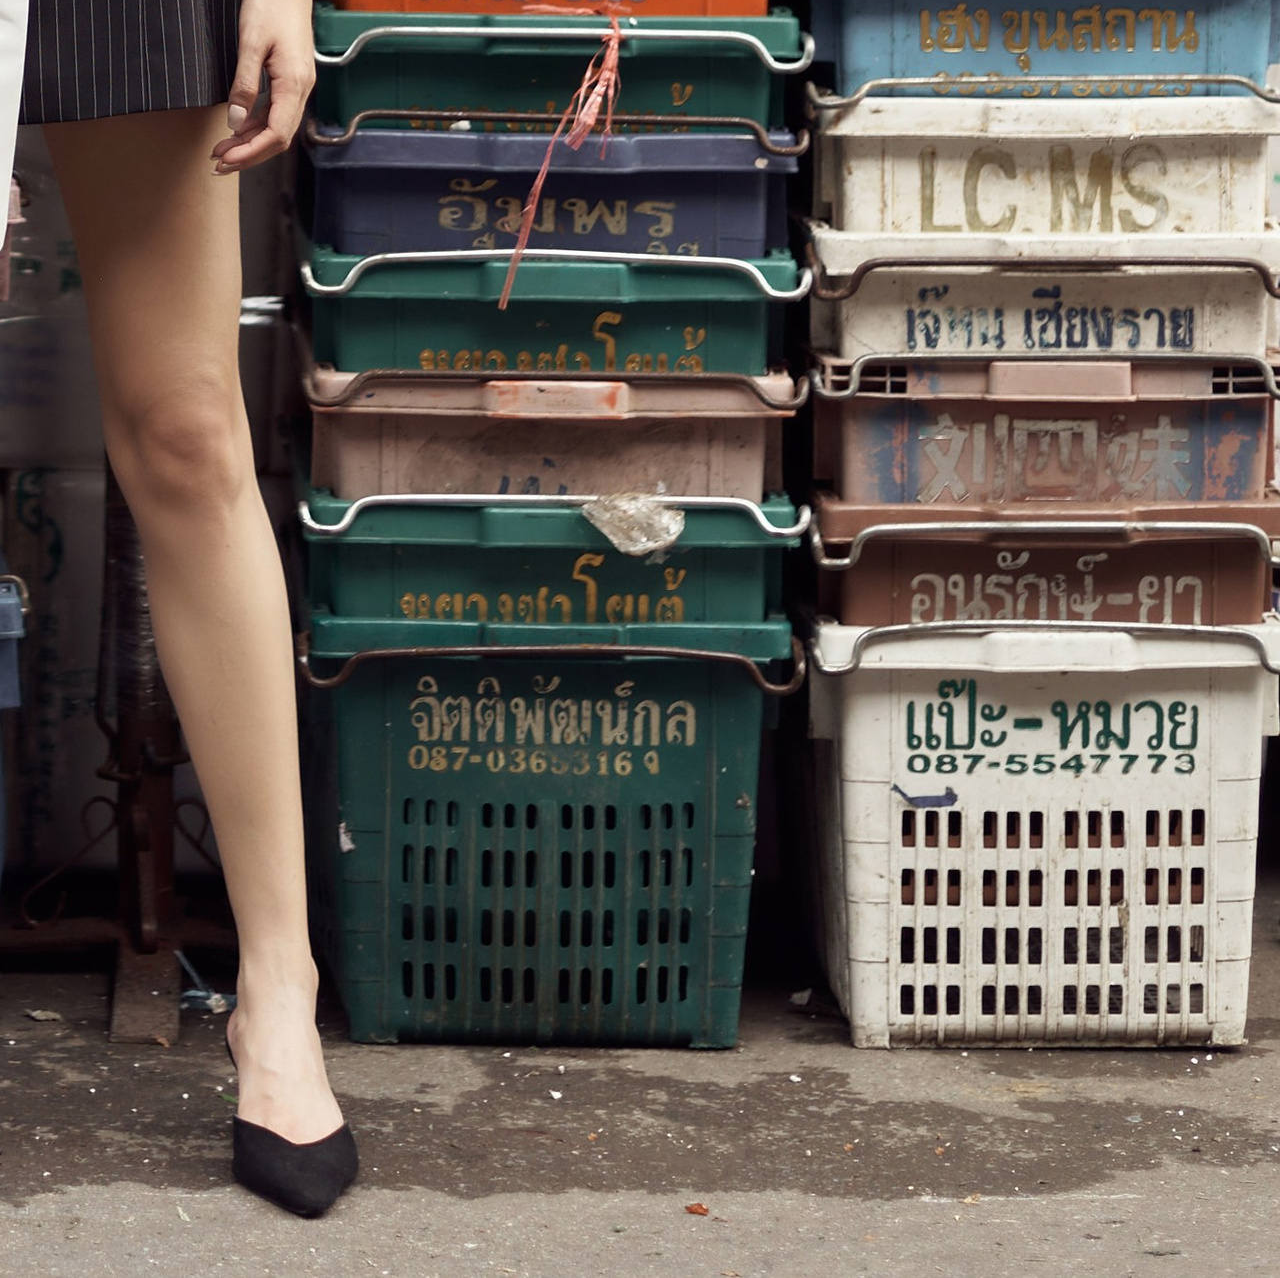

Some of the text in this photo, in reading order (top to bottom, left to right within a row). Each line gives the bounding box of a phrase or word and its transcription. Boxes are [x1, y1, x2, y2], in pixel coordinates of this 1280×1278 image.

[920, 3, 1200, 73] เฮง ขุนสถาน
[1023, 285, 1194, 350] เชียงราย
[906, 678, 1199, 750] แป๊ะ-หมวย
[907, 754, 1196, 775] 087-5547773
